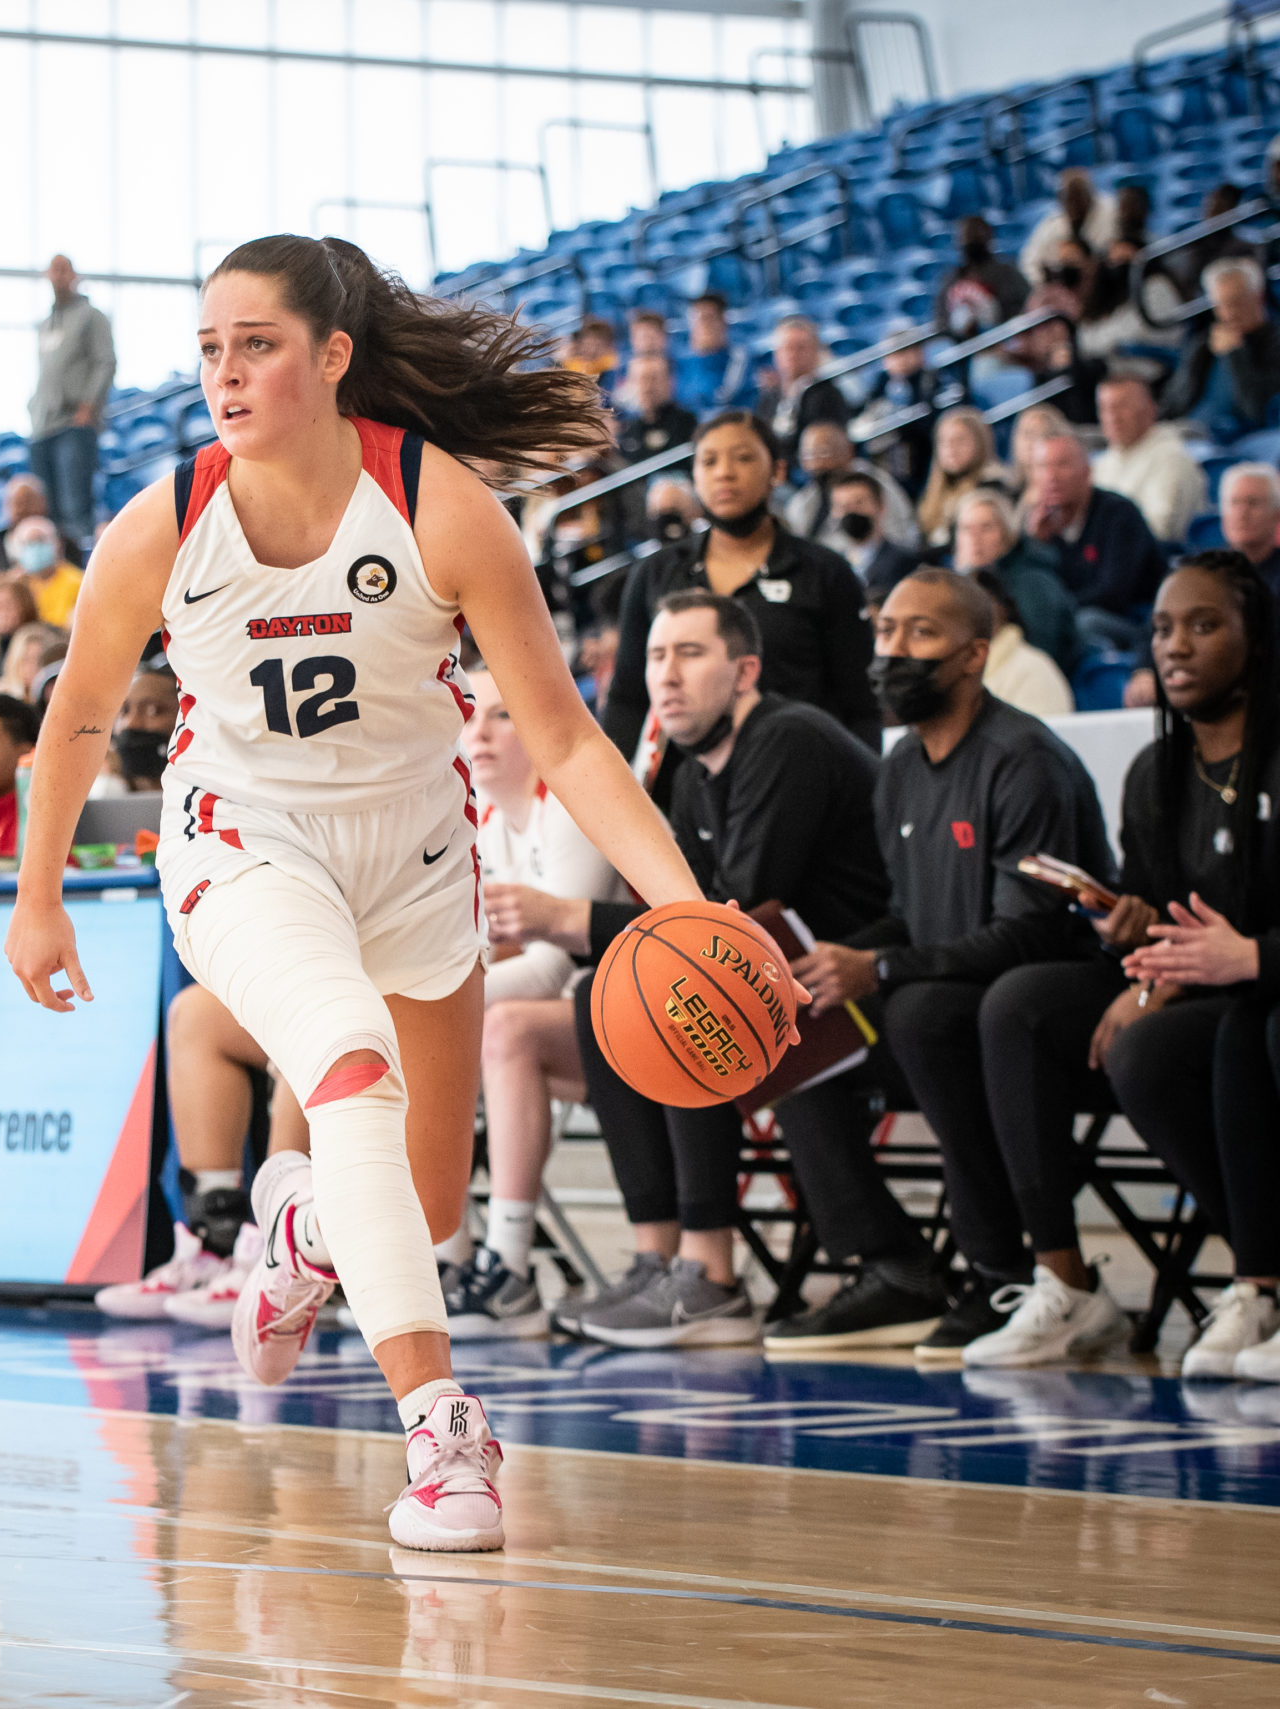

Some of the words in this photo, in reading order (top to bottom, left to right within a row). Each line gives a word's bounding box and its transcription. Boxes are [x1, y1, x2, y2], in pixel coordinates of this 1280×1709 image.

[245, 611, 352, 640] DAYTON
[352, 587, 369, 602] United
[249, 655, 360, 739] 12
[669, 975, 753, 1072] LEGACY
[700, 935, 791, 1049] SPALDING
[680, 1021, 731, 1077] 1000
